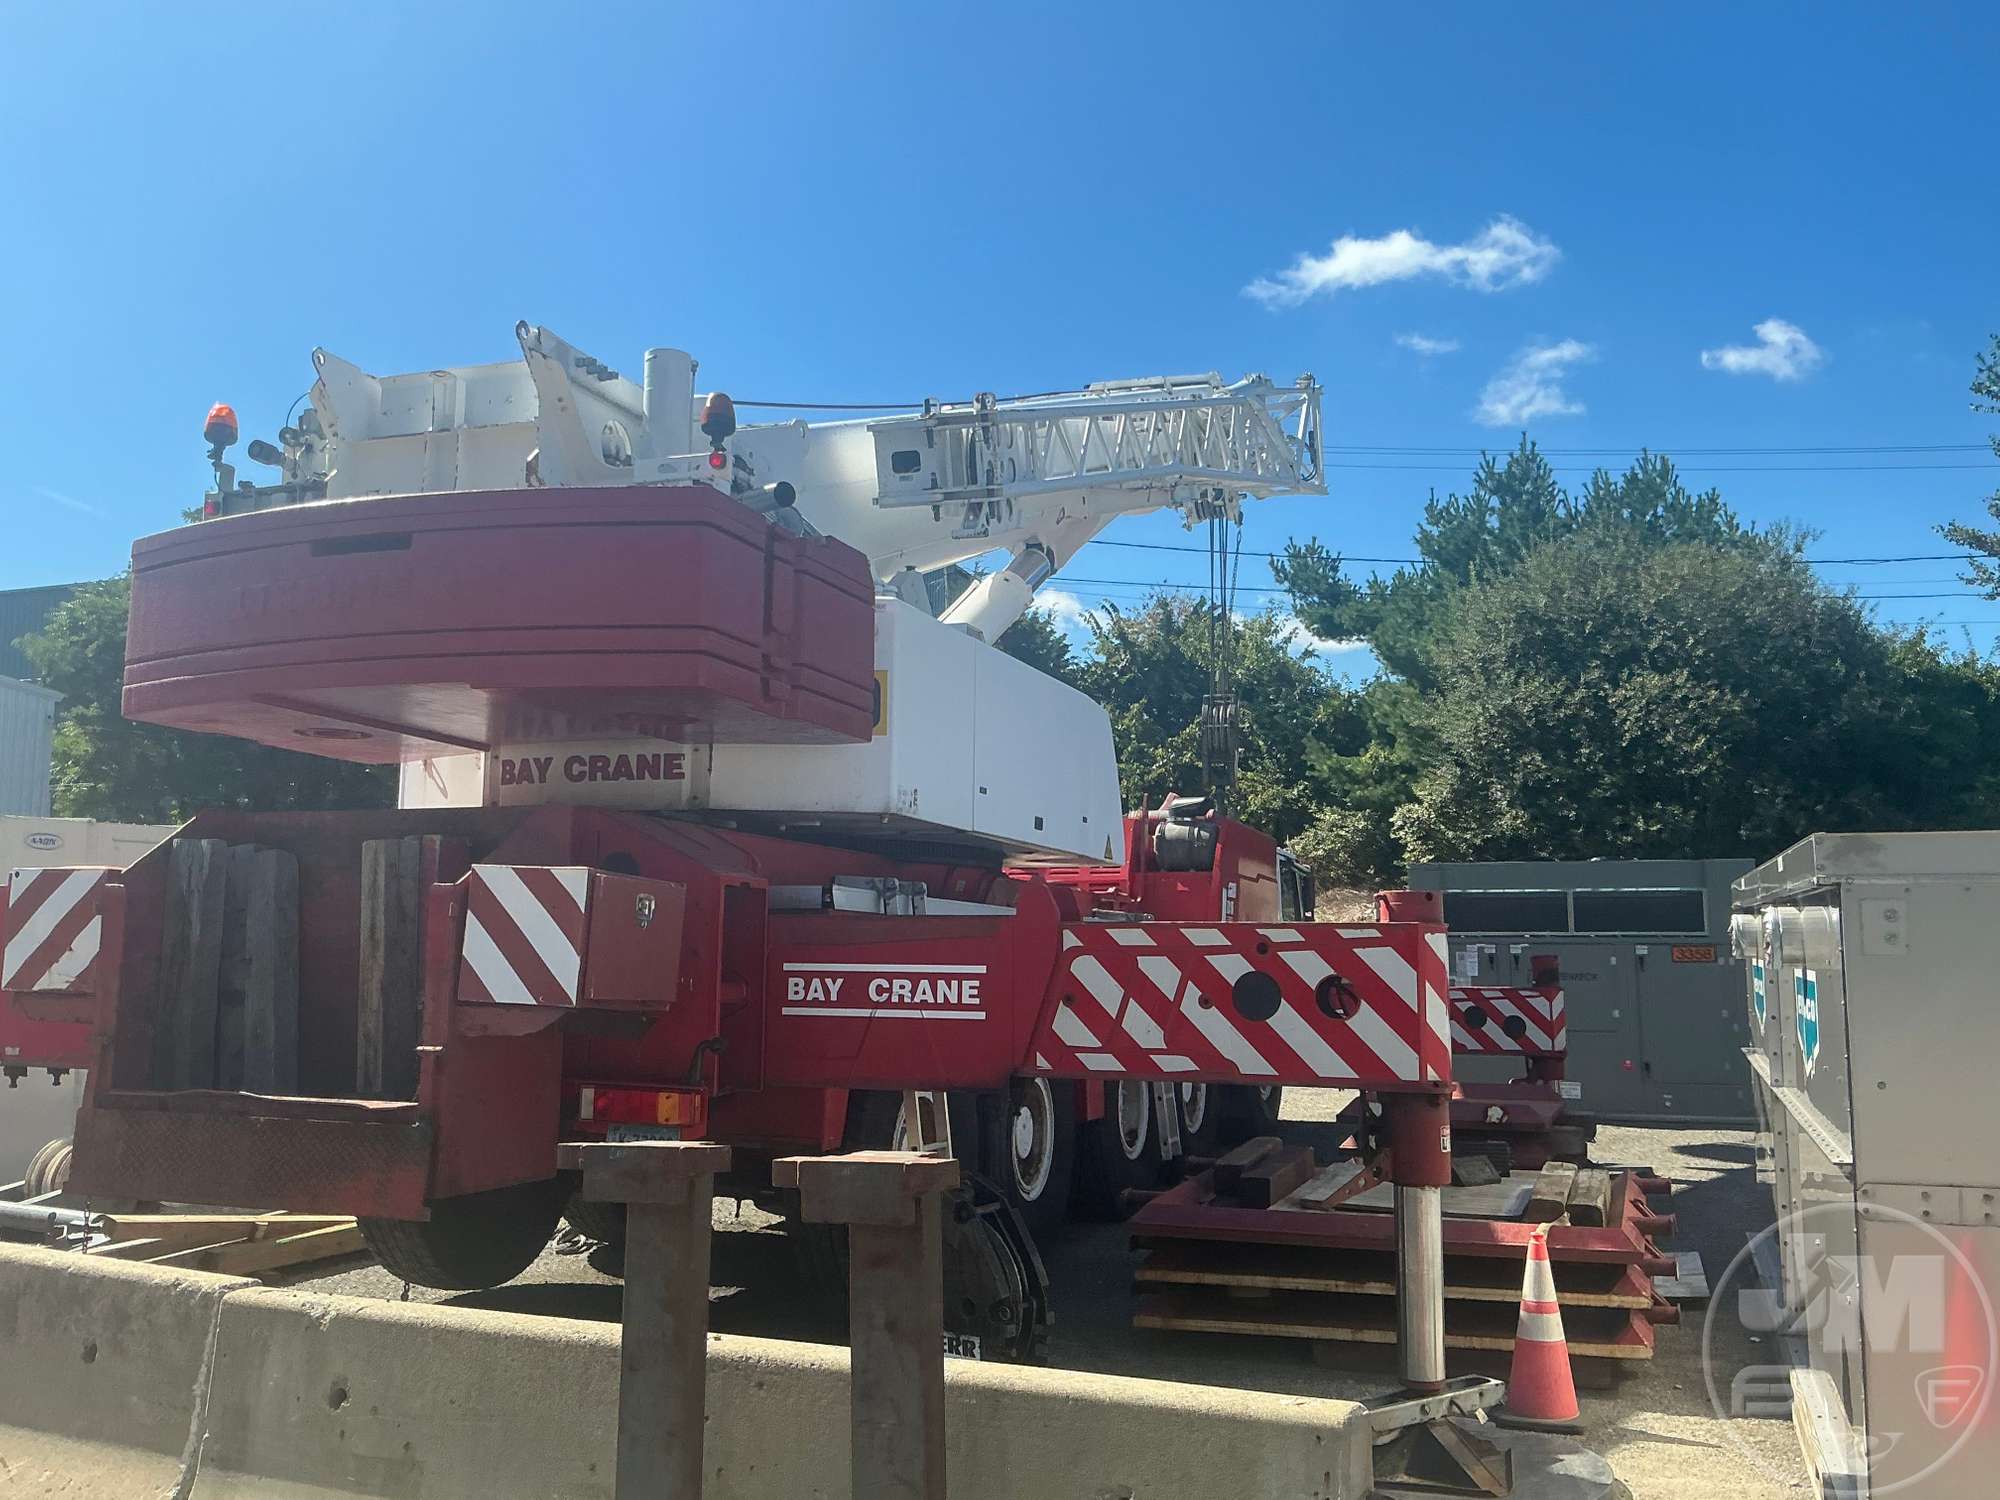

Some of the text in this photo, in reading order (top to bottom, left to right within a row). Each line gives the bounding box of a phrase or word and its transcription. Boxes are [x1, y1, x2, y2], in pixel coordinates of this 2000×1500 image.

[501, 753, 686, 785] BAY CRANE
[787, 977, 980, 1005] BAY CRANE
